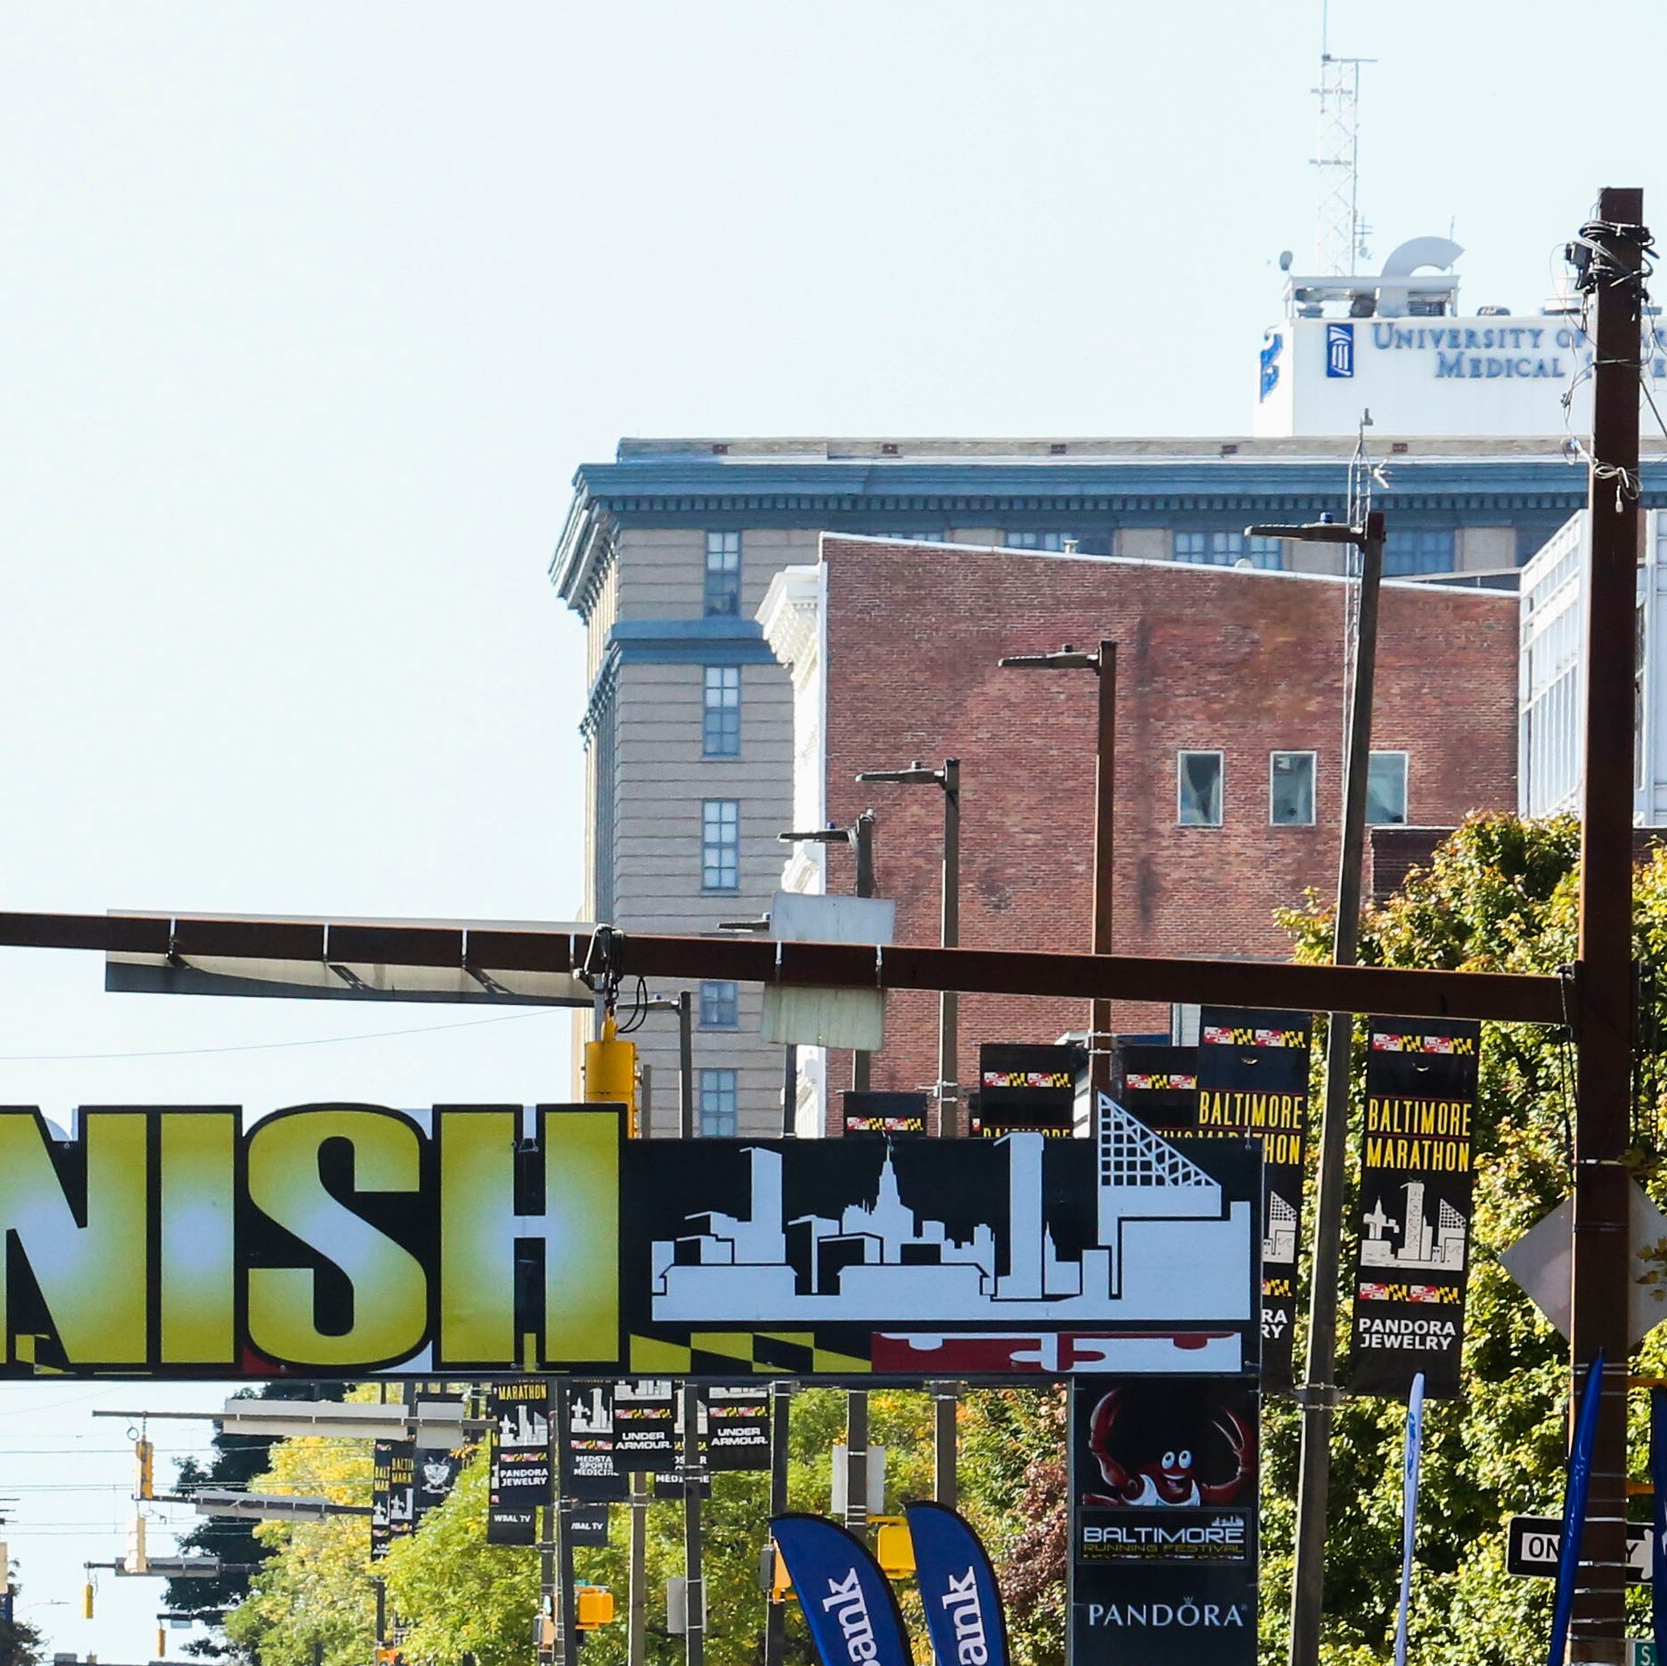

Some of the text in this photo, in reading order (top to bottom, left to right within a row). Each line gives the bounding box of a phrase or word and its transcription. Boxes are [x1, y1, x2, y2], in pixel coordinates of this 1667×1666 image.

[1371, 322, 1545, 350] UNIVERSITY
[1434, 351, 1565, 379] MEDICAL
[1199, 1091, 1304, 1130] BALTIMORE
[1368, 1098, 1472, 1137] BALTIMORE
[1366, 1137, 1470, 1173] MARATHON
[1358, 1317, 1456, 1336] PANDORA
[1359, 1333, 1454, 1351] JEWELRY
[498, 1384, 548, 1401] MARATHON
[622, 1432, 665, 1441] UNDER
[717, 1427, 761, 1437] UNDER
[499, 1467, 549, 1479] PANDORA
[501, 1476, 547, 1487] JEWELRY
[519, 1514, 531, 1523] TV
[592, 1522, 603, 1531] TV
[1082, 1526, 1245, 1544] BALTIMORE
[1082, 1543, 1244, 1554] RUNNING FESTIVAL
[1088, 1603, 1245, 1627] PANDORA
[1640, 1645, 1656, 1666] S.
